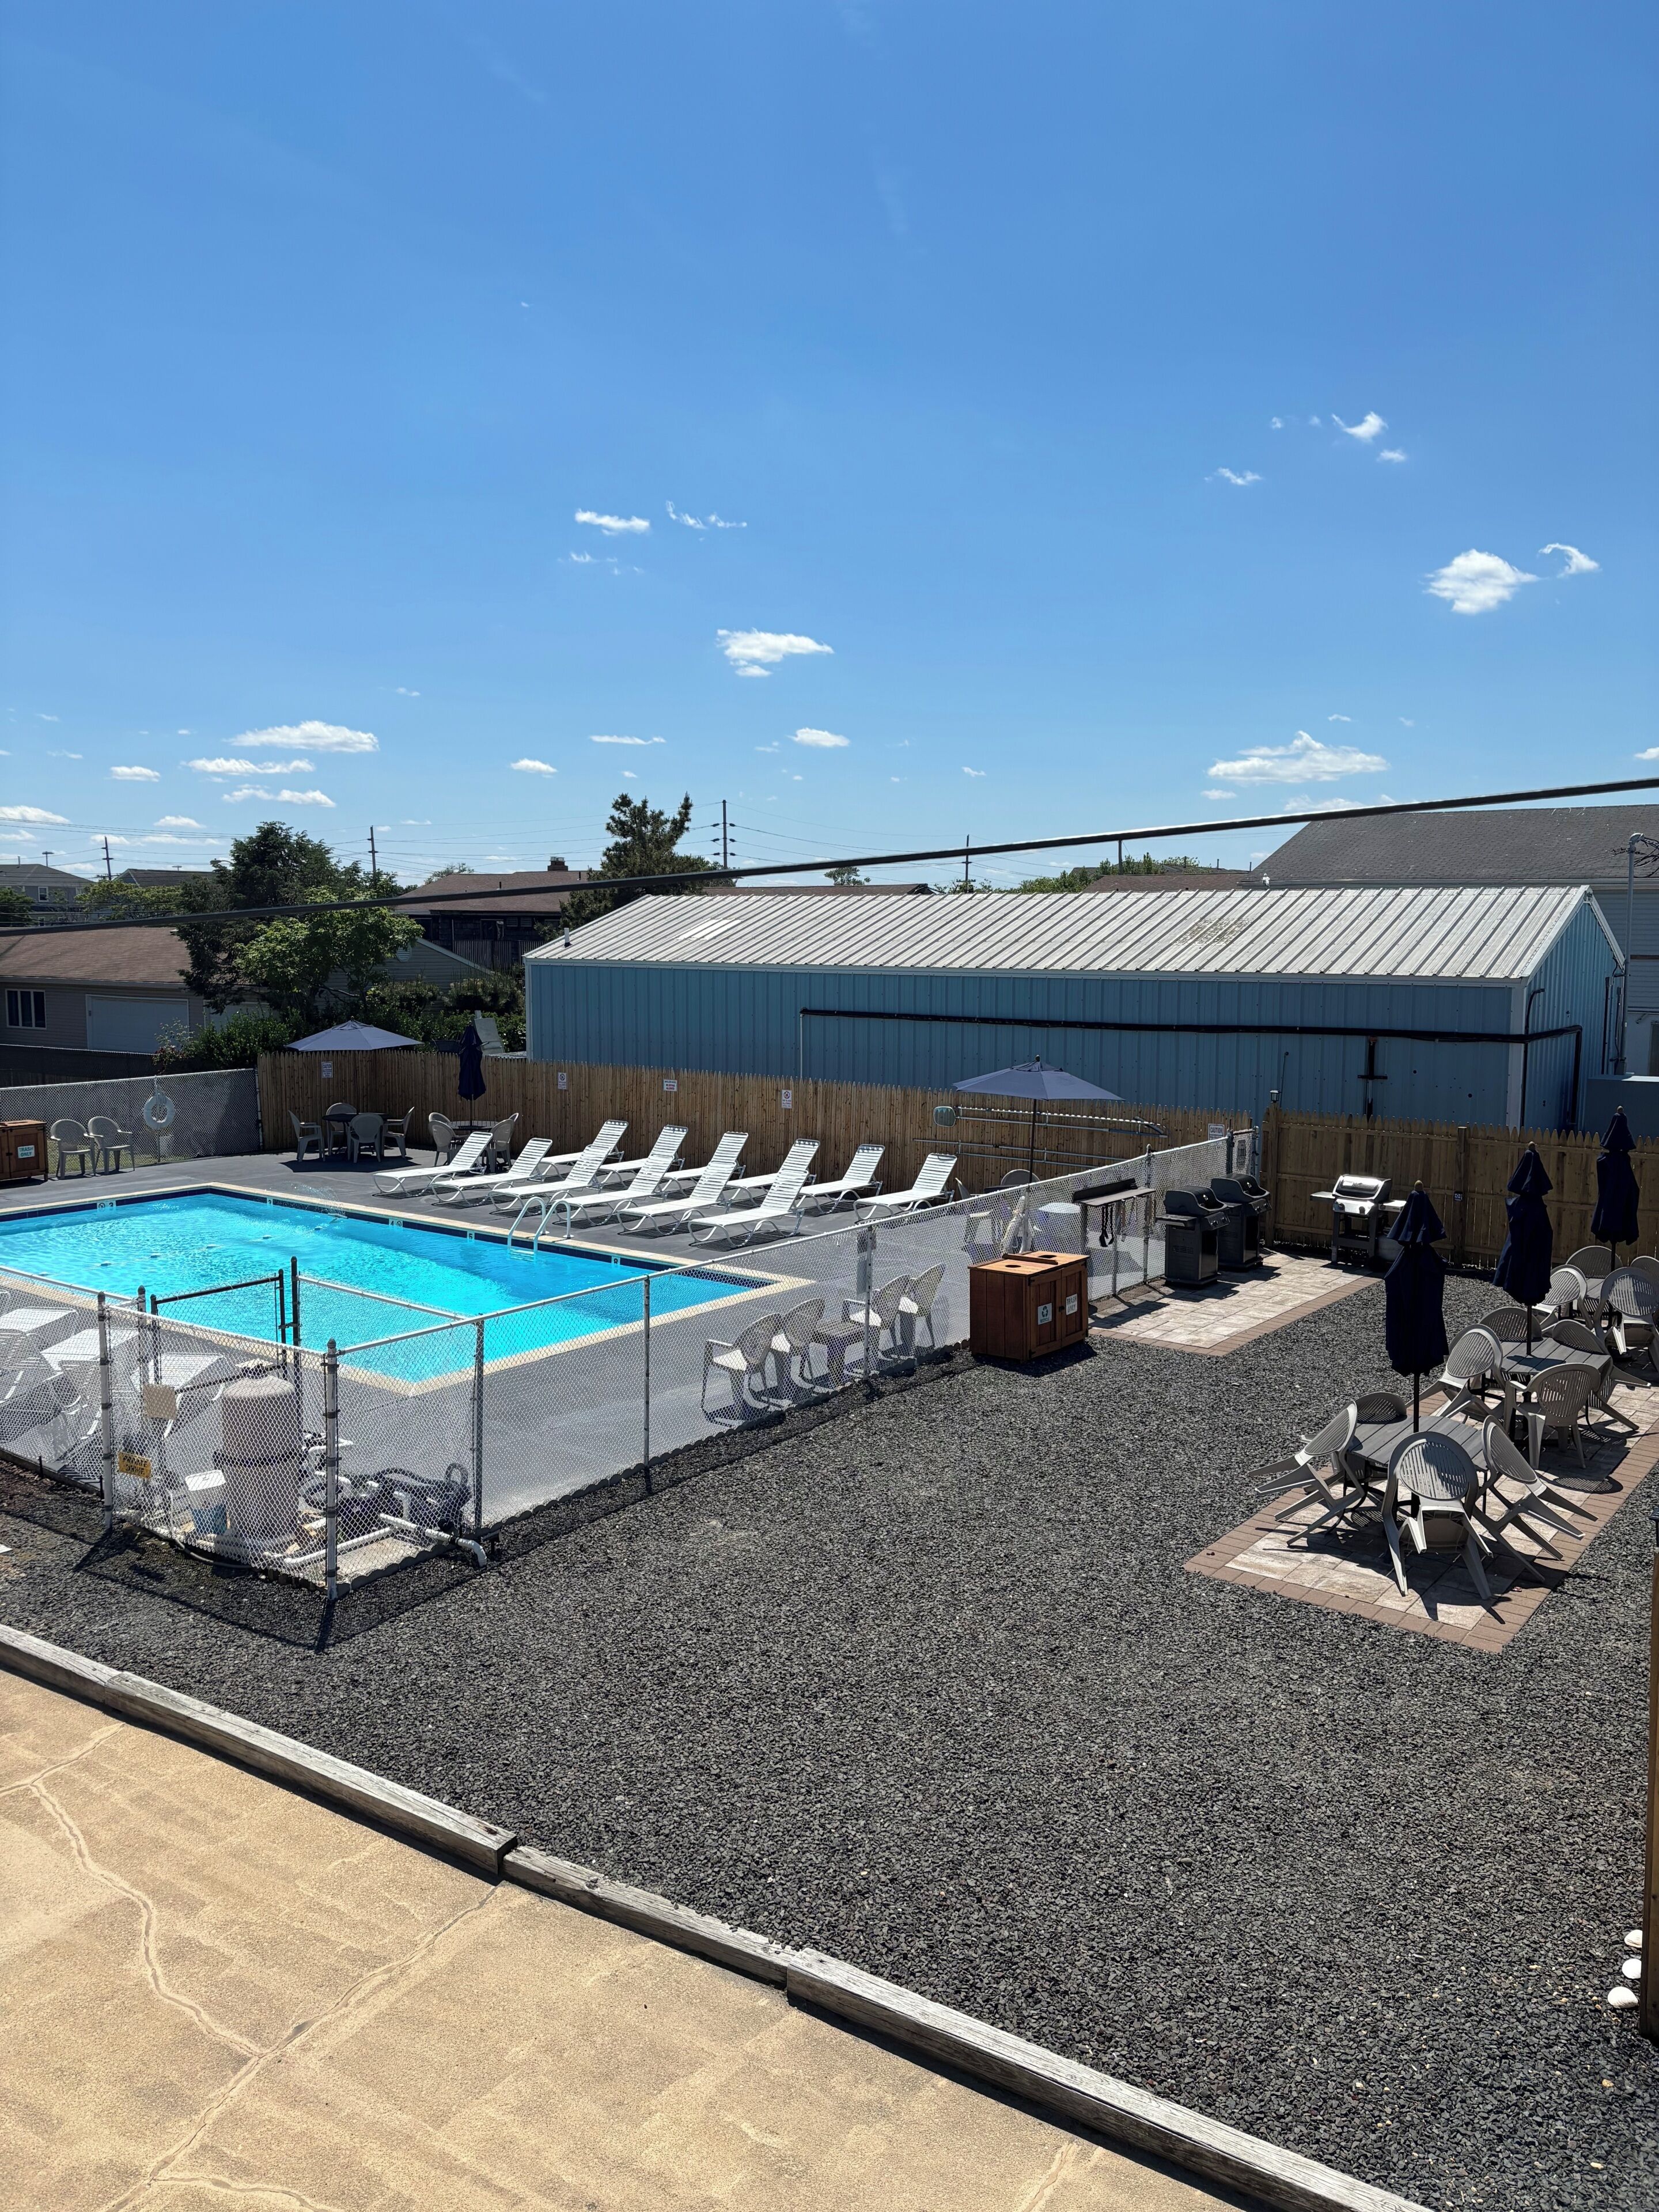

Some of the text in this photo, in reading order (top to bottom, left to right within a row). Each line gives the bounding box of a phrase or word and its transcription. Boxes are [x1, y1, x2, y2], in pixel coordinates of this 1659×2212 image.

[1067, 1296, 1077, 1305] TRASH
[1067, 1305, 1075, 1313] ONLY
[123, 1455, 147, 1467] PRIVATE
[126, 1464, 145, 1475] DRIVE
